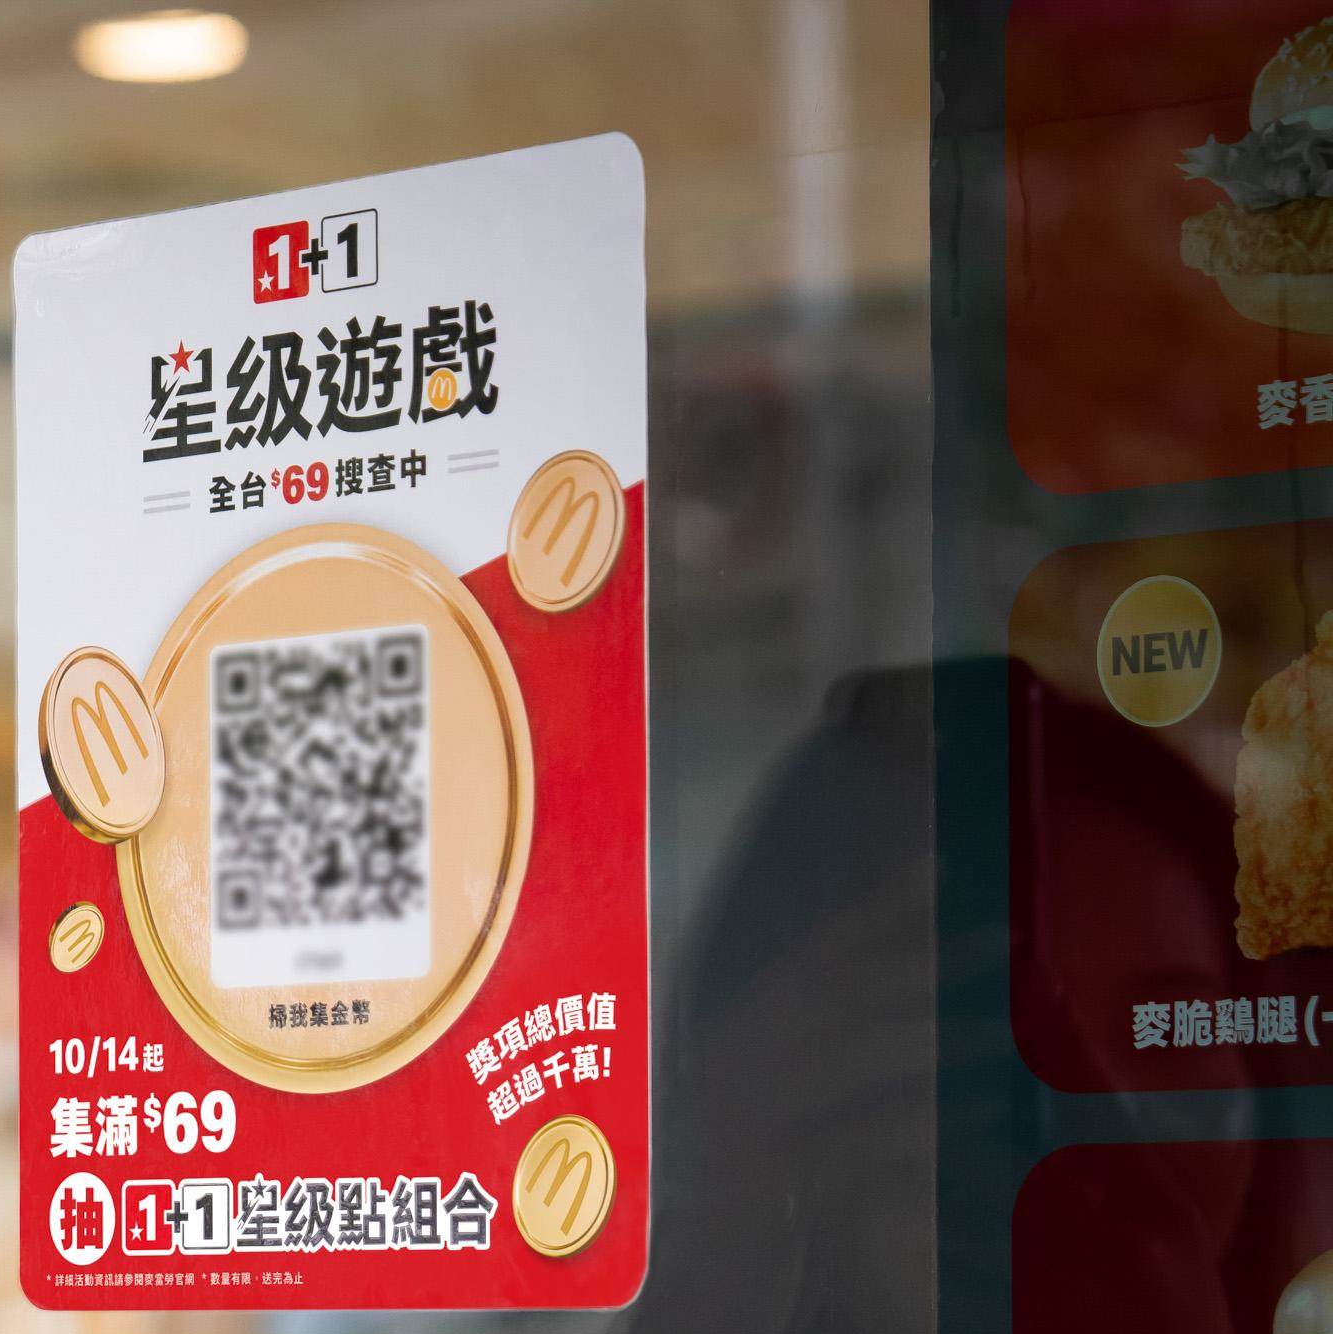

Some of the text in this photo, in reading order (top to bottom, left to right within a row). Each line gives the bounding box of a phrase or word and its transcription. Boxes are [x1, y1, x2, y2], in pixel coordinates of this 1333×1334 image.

[263, 213, 371, 296] 1+1
[143, 300, 499, 463] 星級遊戲
[209, 449, 428, 514] 全台$69搜查中
[1111, 629, 1208, 677] NEW
[268, 999, 372, 1030] 掃我集金幣
[465, 991, 618, 1086] 獎項總價值
[49, 1036, 165, 1078] 10/14起
[486, 1043, 612, 1126] 超過千萬!
[48, 1090, 237, 1159] 集滿$69
[59, 1175, 494, 1252] 抽 1+1 星級點組合
